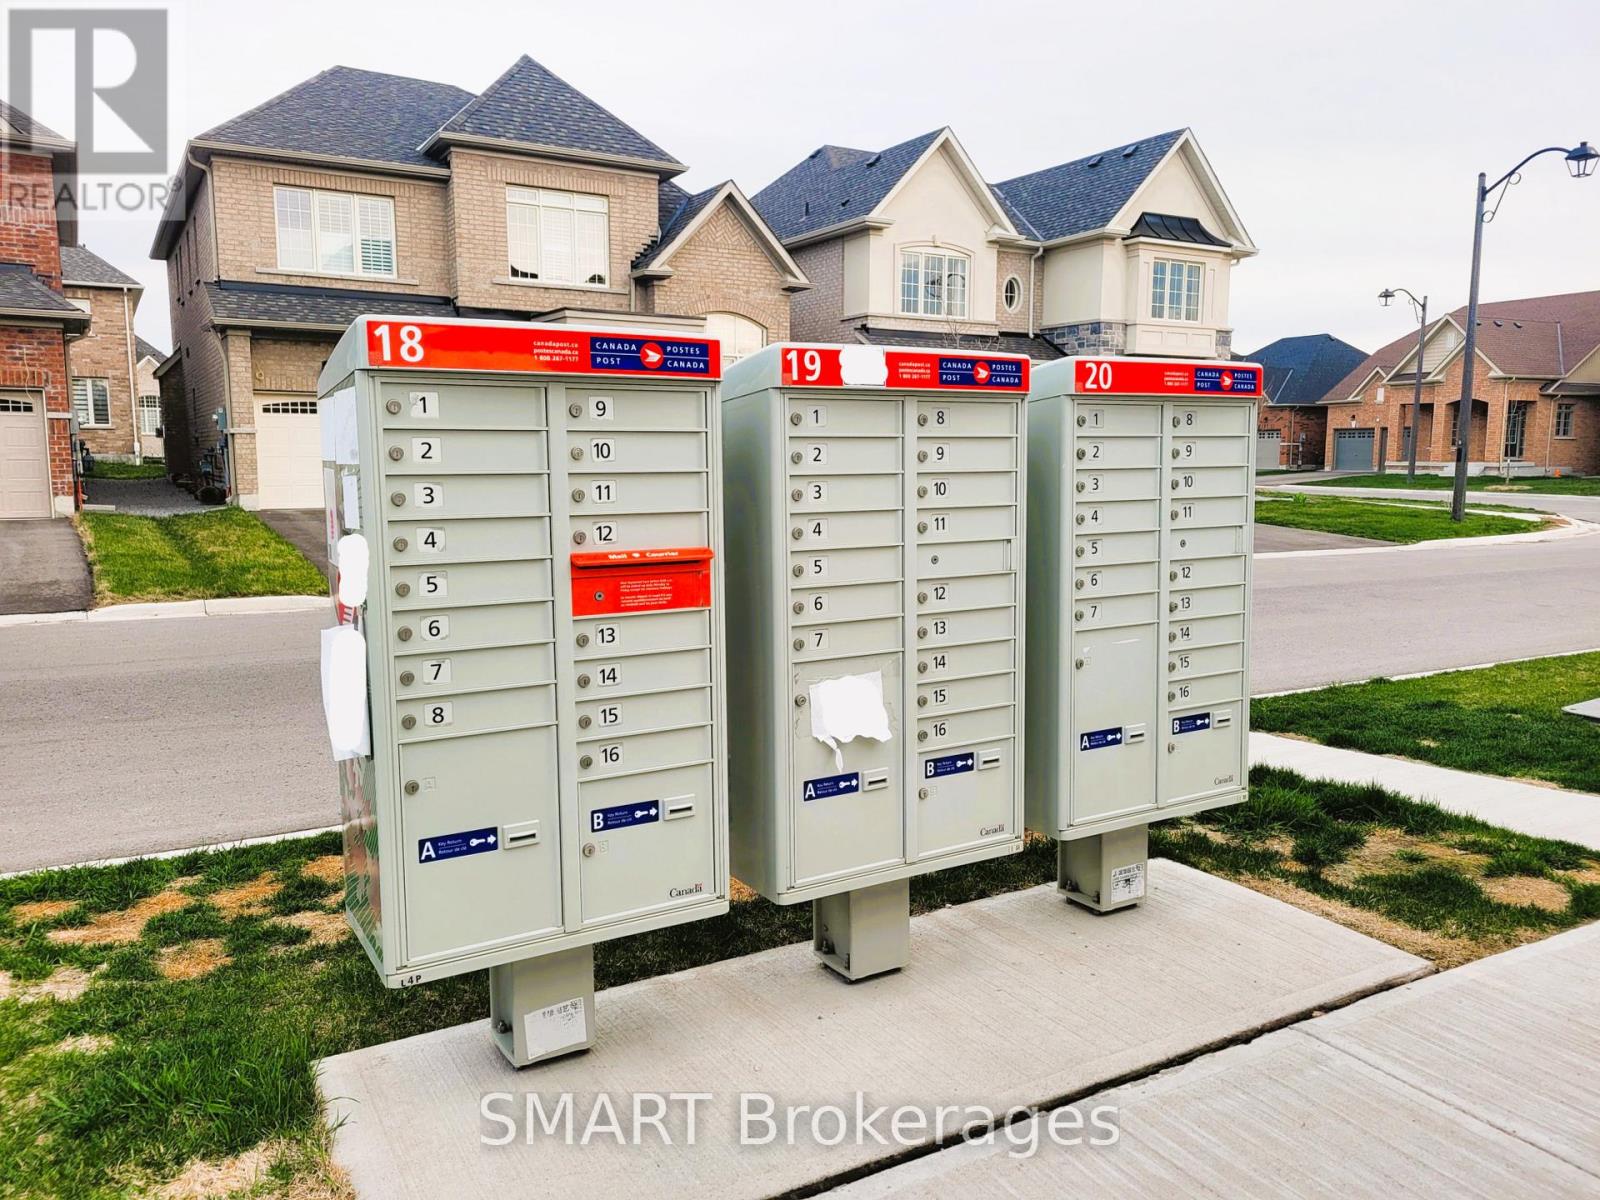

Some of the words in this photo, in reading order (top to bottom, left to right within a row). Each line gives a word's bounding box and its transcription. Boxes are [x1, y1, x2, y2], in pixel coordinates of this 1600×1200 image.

[373, 324, 424, 363] 18
[595, 341, 637, 351] CANADA
[666, 346, 700, 355] POSTES
[596, 357, 621, 365] POST
[667, 360, 705, 369] CANADA
[786, 350, 821, 381] 19
[942, 361, 972, 369] CANADA
[1084, 362, 1113, 390] 20
[419, 396, 427, 413] 1
[595, 400, 606, 417] 9
[813, 409, 819, 424] 1
[936, 410, 945, 425] 8
[1093, 412, 1099, 426] 1
[1186, 413, 1193, 426] 8
[420, 441, 433, 459] 2
[593, 442, 611, 459] 10
[813, 447, 822, 462] 2
[936, 446, 944, 460] 9
[1092, 445, 1100, 459] 2
[1185, 444, 1192, 457] 9
[933, 482, 946, 496] 10
[1092, 477, 1099, 491] 3
[1183, 475, 1193, 488] 10
[422, 486, 435, 504] 3
[595, 484, 611, 500] 11
[813, 484, 822, 500] 3
[1091, 509, 1098, 523] 4
[1183, 506, 1192, 518] 11
[812, 522, 822, 536] 4
[934, 516, 945, 531] 11
[423, 531, 437, 548] 4
[595, 525, 612, 541] 12
[1091, 541, 1098, 555] 5
[814, 559, 822, 574] 5
[1181, 566, 1191, 579] 12
[426, 575, 438, 593] 5
[1090, 573, 1098, 587] 6
[933, 586, 946, 600] 12
[814, 596, 823, 611] 6
[1181, 596, 1191, 609] 13
[1090, 605, 1097, 618] 7
[428, 619, 441, 637] 6
[598, 627, 615, 643] 13
[933, 621, 946, 635] 13
[1180, 626, 1190, 640] 14
[814, 632, 823, 647] 7
[933, 655, 946, 669] 14
[1179, 655, 1190, 669] 15
[430, 663, 442, 681] 7
[599, 667, 617, 684] 14
[933, 689, 946, 703] 15
[1179, 685, 1190, 699] 16
[432, 706, 444, 724] 8
[600, 707, 618, 724] 15
[933, 722, 947, 737] 16
[1173, 720, 1180, 733] B
[1081, 735, 1090, 750] A
[601, 746, 620, 763] 16
[926, 761, 935, 776] B
[805, 782, 816, 799] A
[593, 812, 604, 830] B
[420, 841, 436, 860] A
